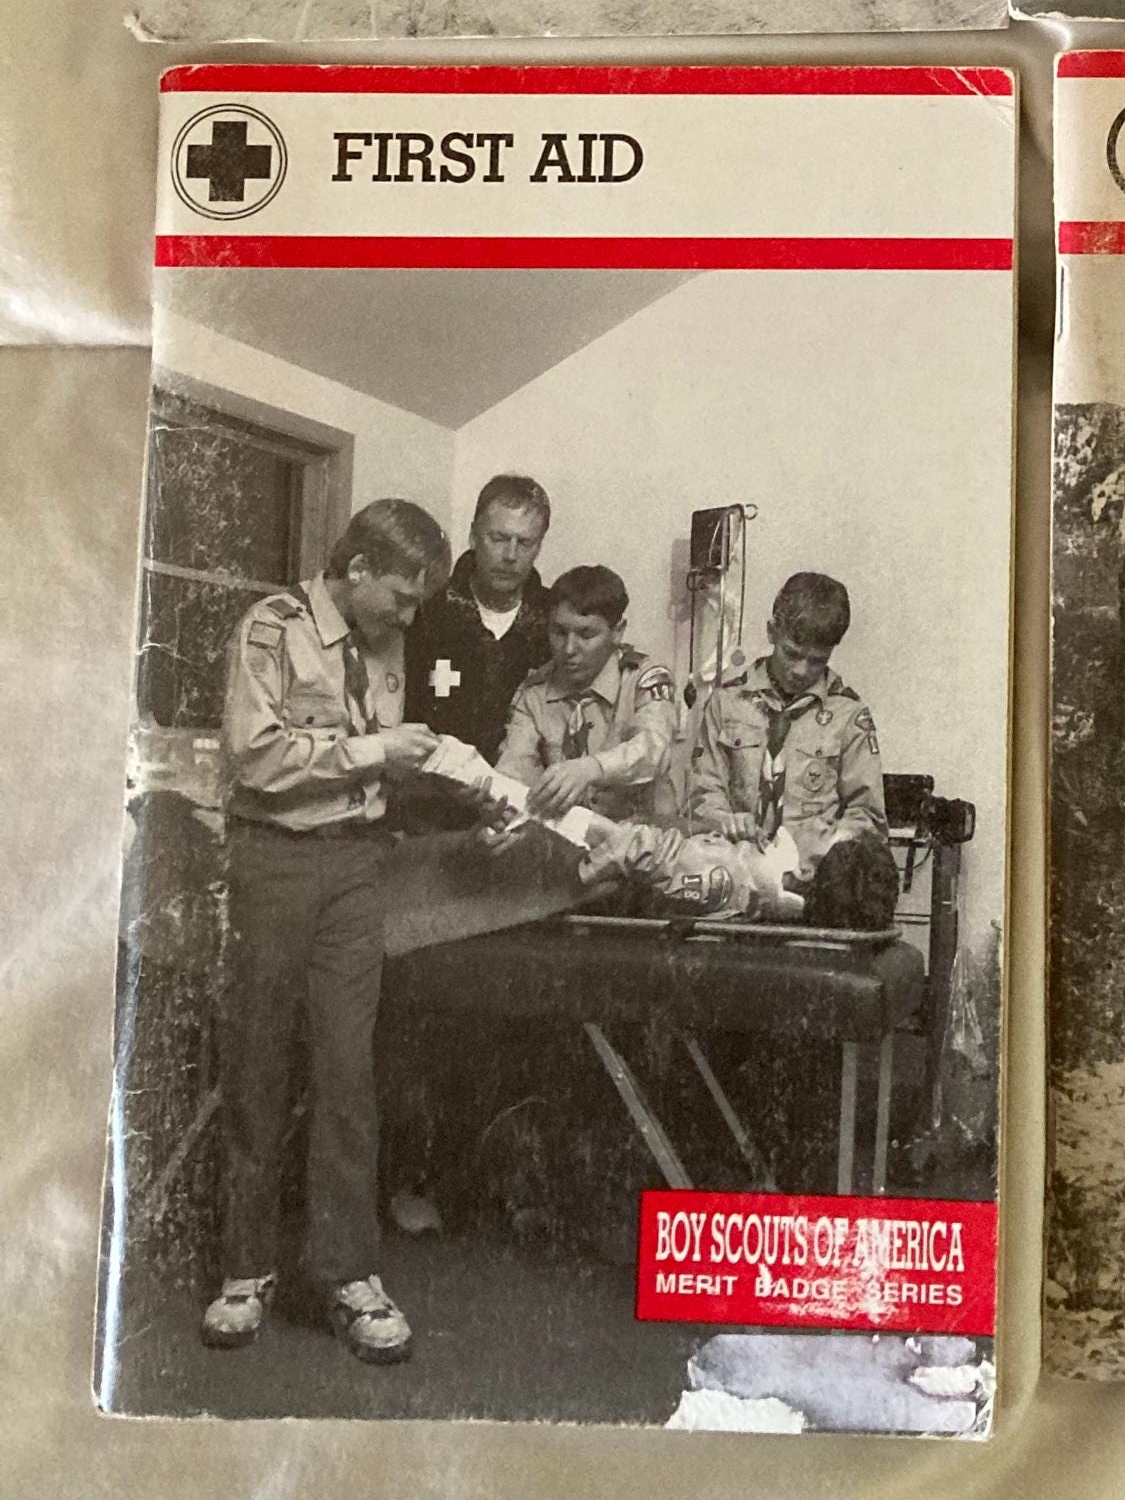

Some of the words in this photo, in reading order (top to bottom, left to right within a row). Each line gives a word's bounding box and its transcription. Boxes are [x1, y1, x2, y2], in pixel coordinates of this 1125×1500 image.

[331, 131, 514, 184] FIRST
[529, 132, 645, 184] AID
[655, 1211, 707, 1262] BOY
[711, 1212, 808, 1266] SCOUTS
[813, 1215, 847, 1267] OF
[852, 1218, 965, 1272] AMERICA
[655, 1273, 739, 1296] MERIT
[755, 1275, 847, 1300] BADGE
[867, 1282, 964, 1305] SERIES
